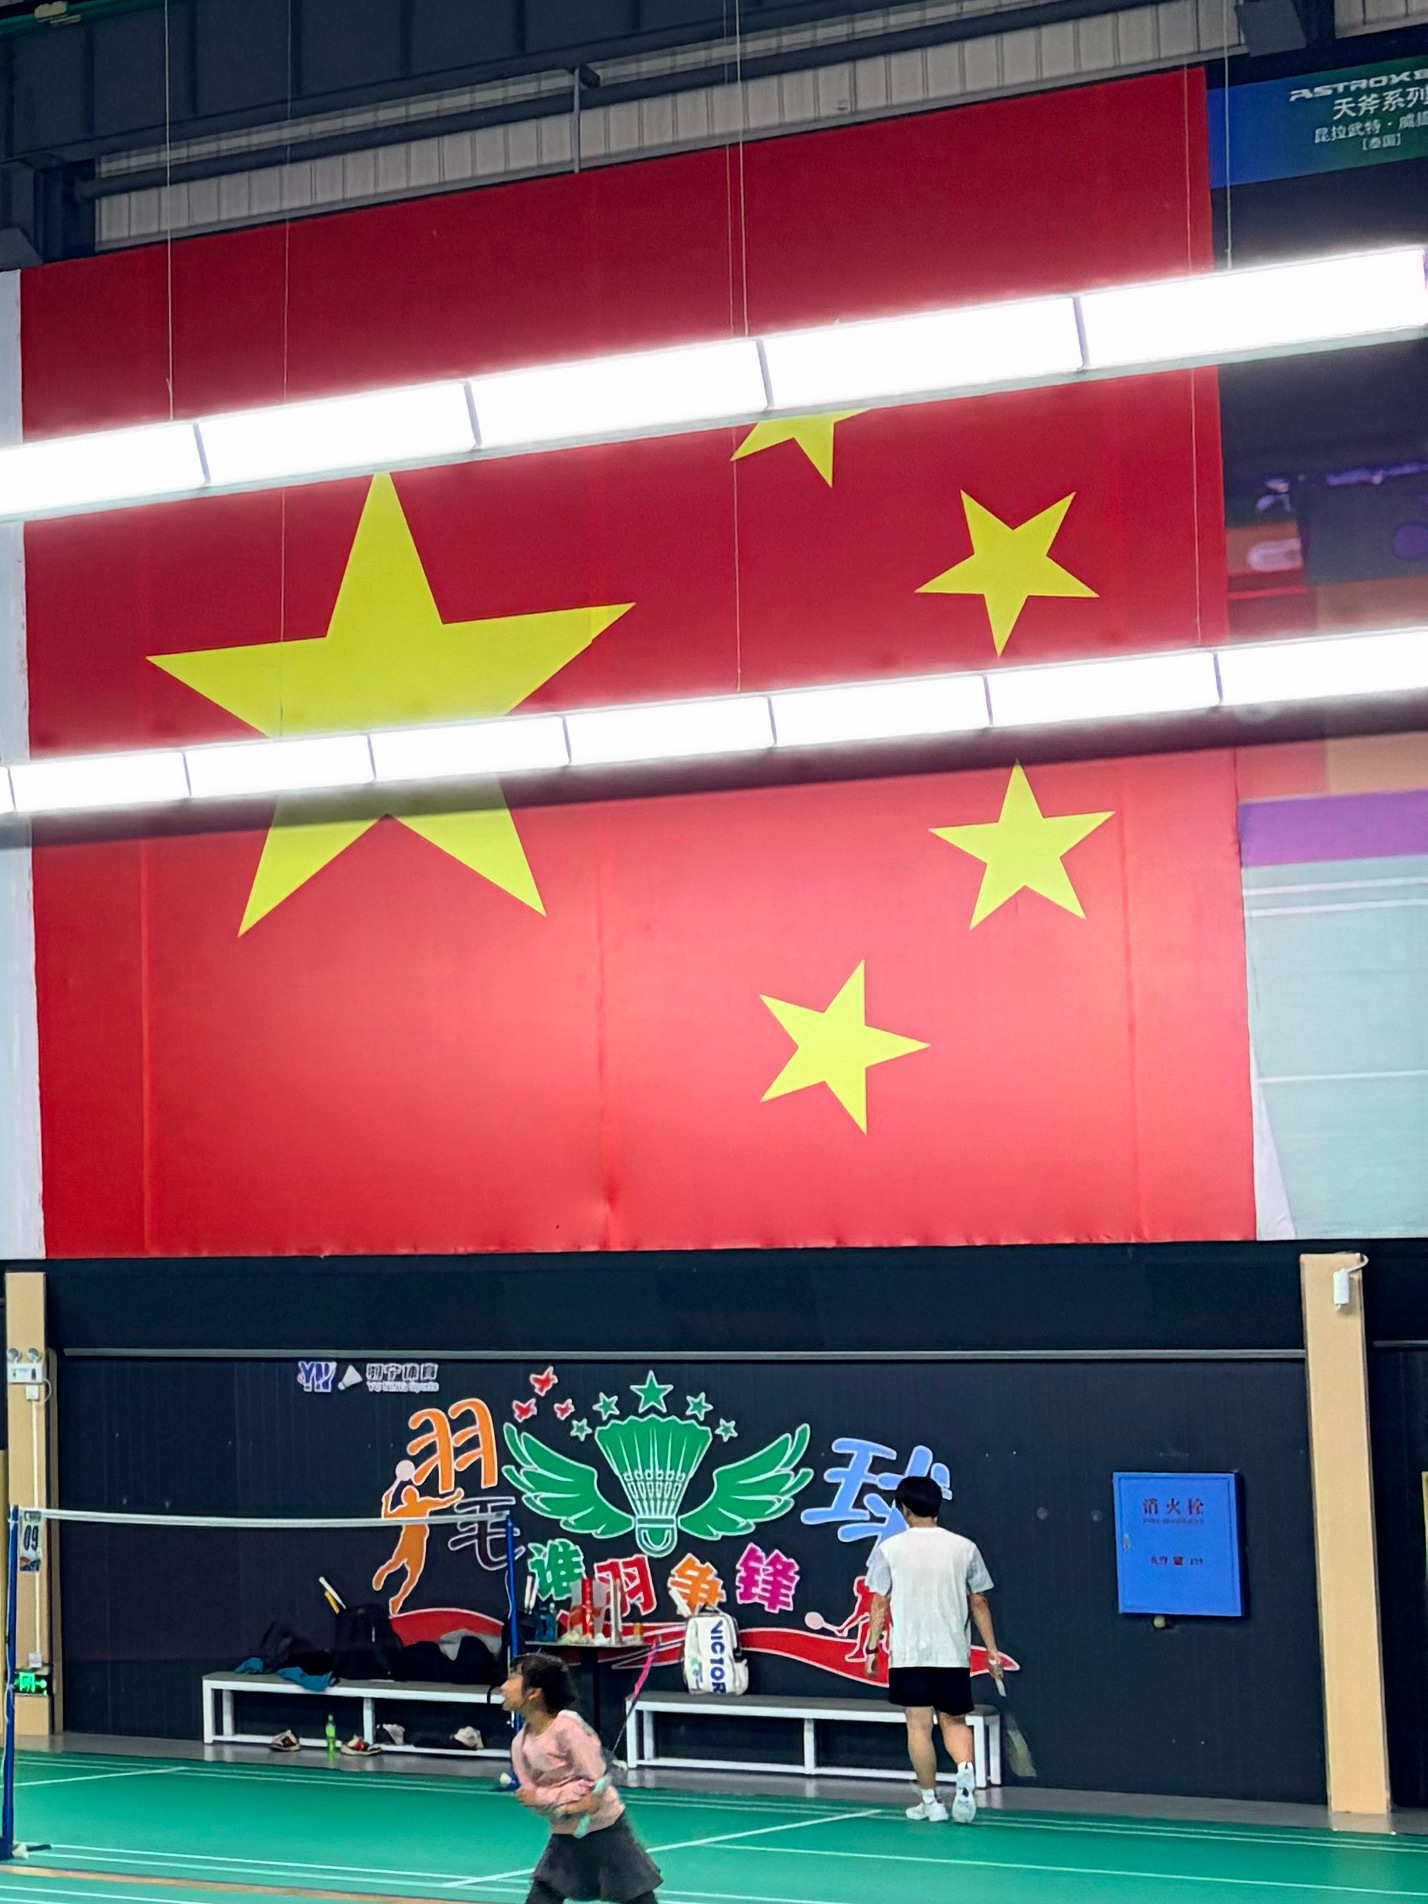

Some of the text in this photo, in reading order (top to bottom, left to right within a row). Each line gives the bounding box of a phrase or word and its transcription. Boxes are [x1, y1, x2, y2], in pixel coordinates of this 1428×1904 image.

[1333, 84, 1428, 121] 天斧系列
[23, 1524, 40, 1551] 09
[527, 1537, 801, 1617] 谁羽争锋
[708, 1619, 727, 1695] VICTOR
